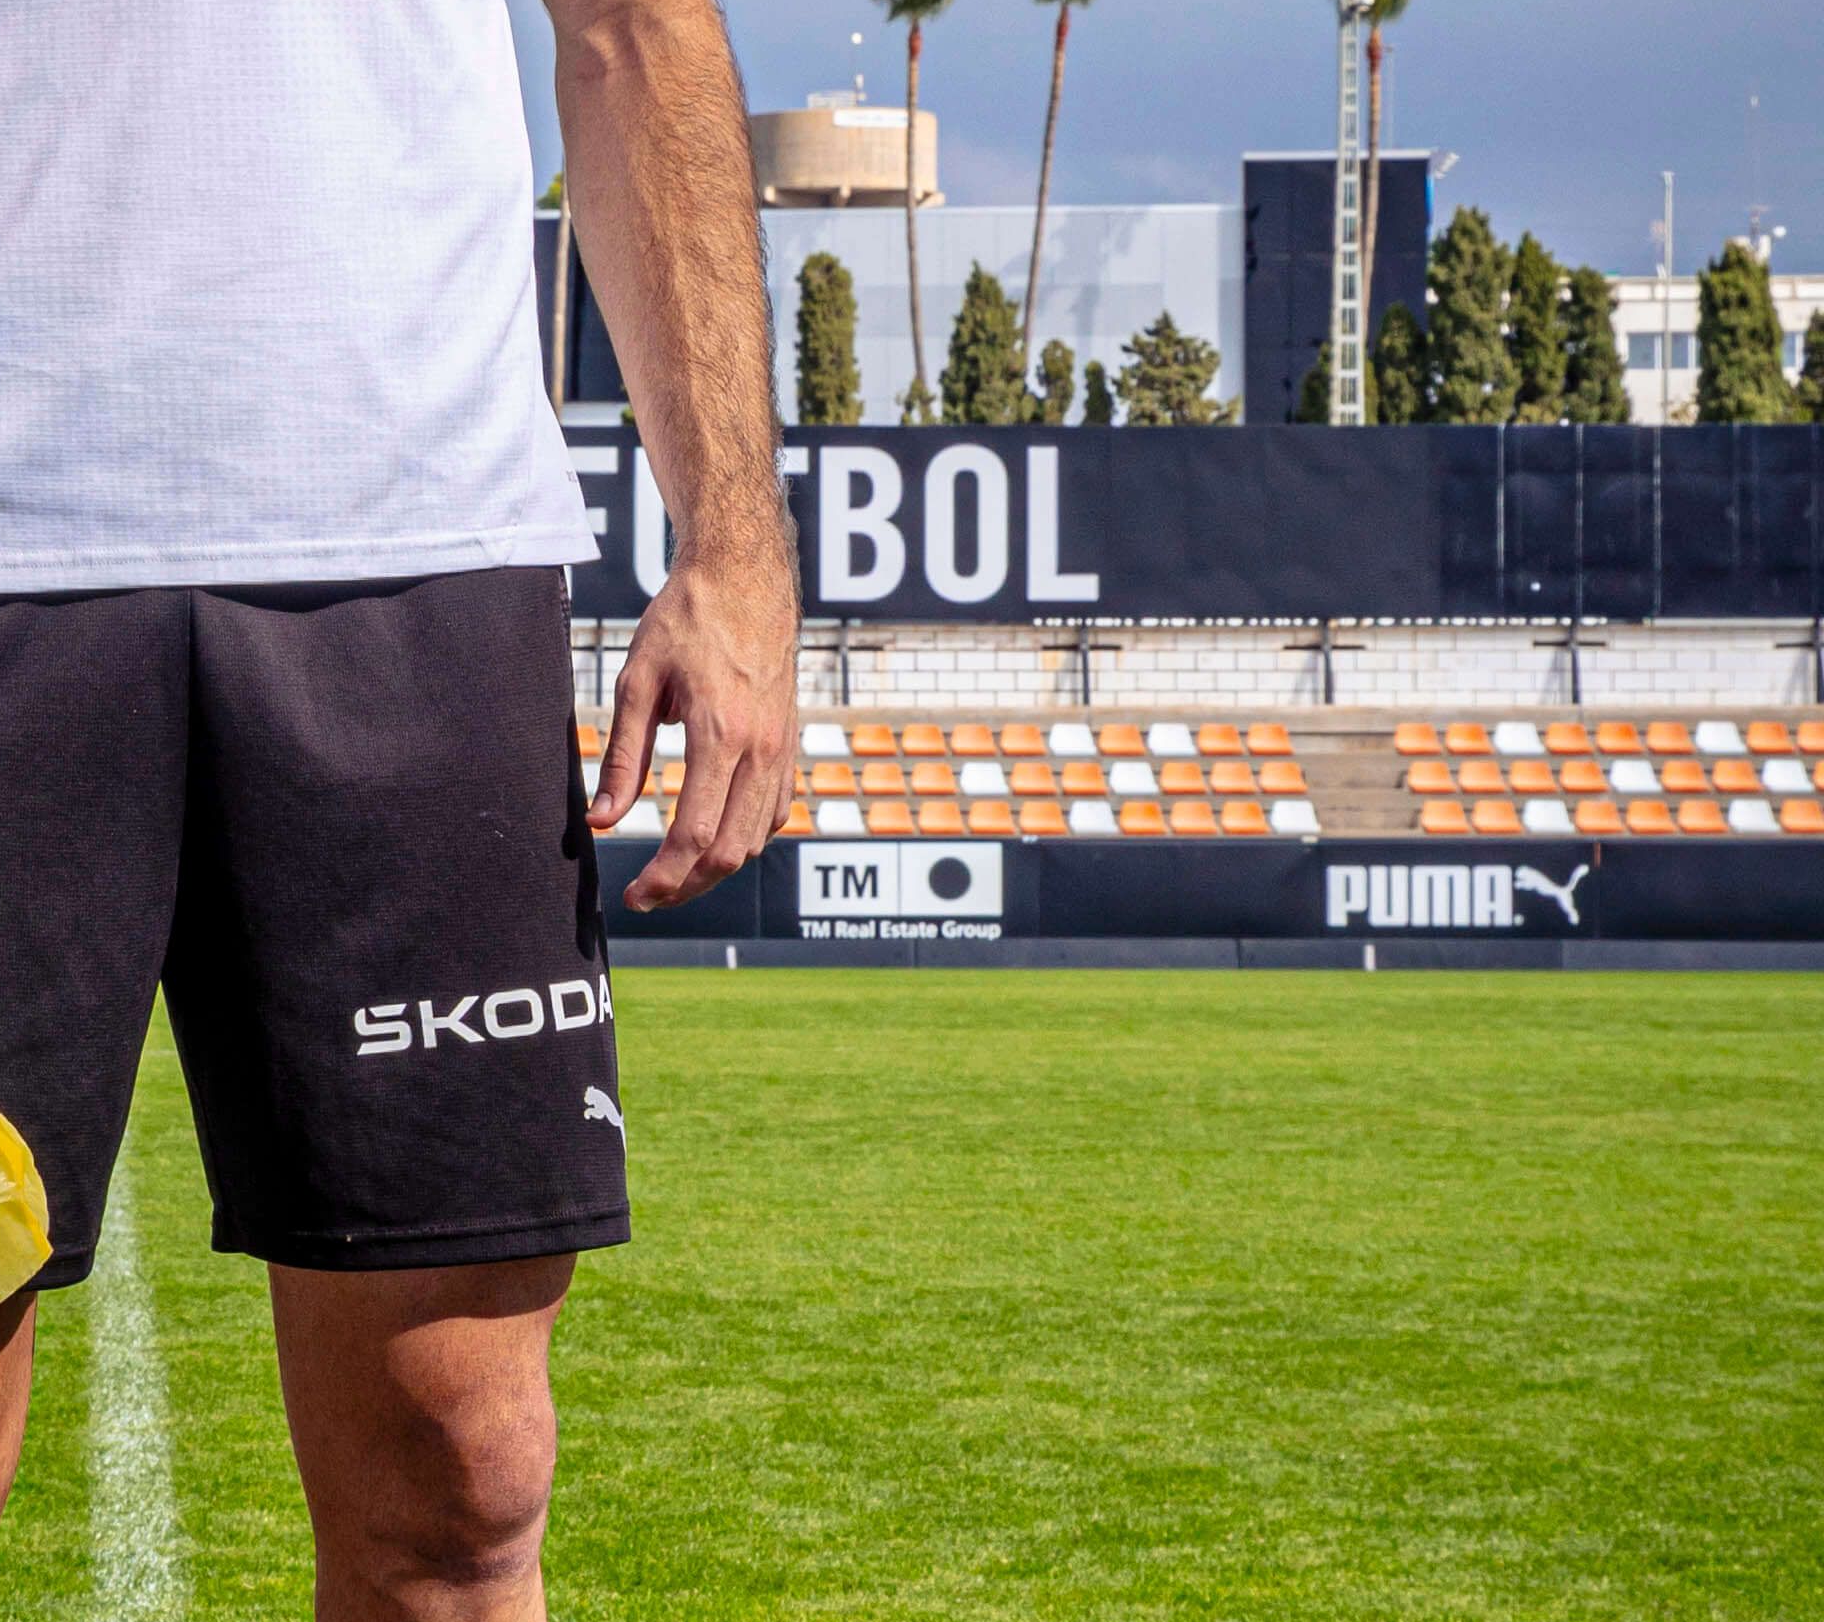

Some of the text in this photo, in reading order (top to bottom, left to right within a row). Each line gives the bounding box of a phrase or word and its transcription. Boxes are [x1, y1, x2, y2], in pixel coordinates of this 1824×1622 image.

[814, 865, 878, 898] TM
[1326, 864, 1513, 927] PUMA
[799, 920, 1002, 941] TM Real Estate Group
